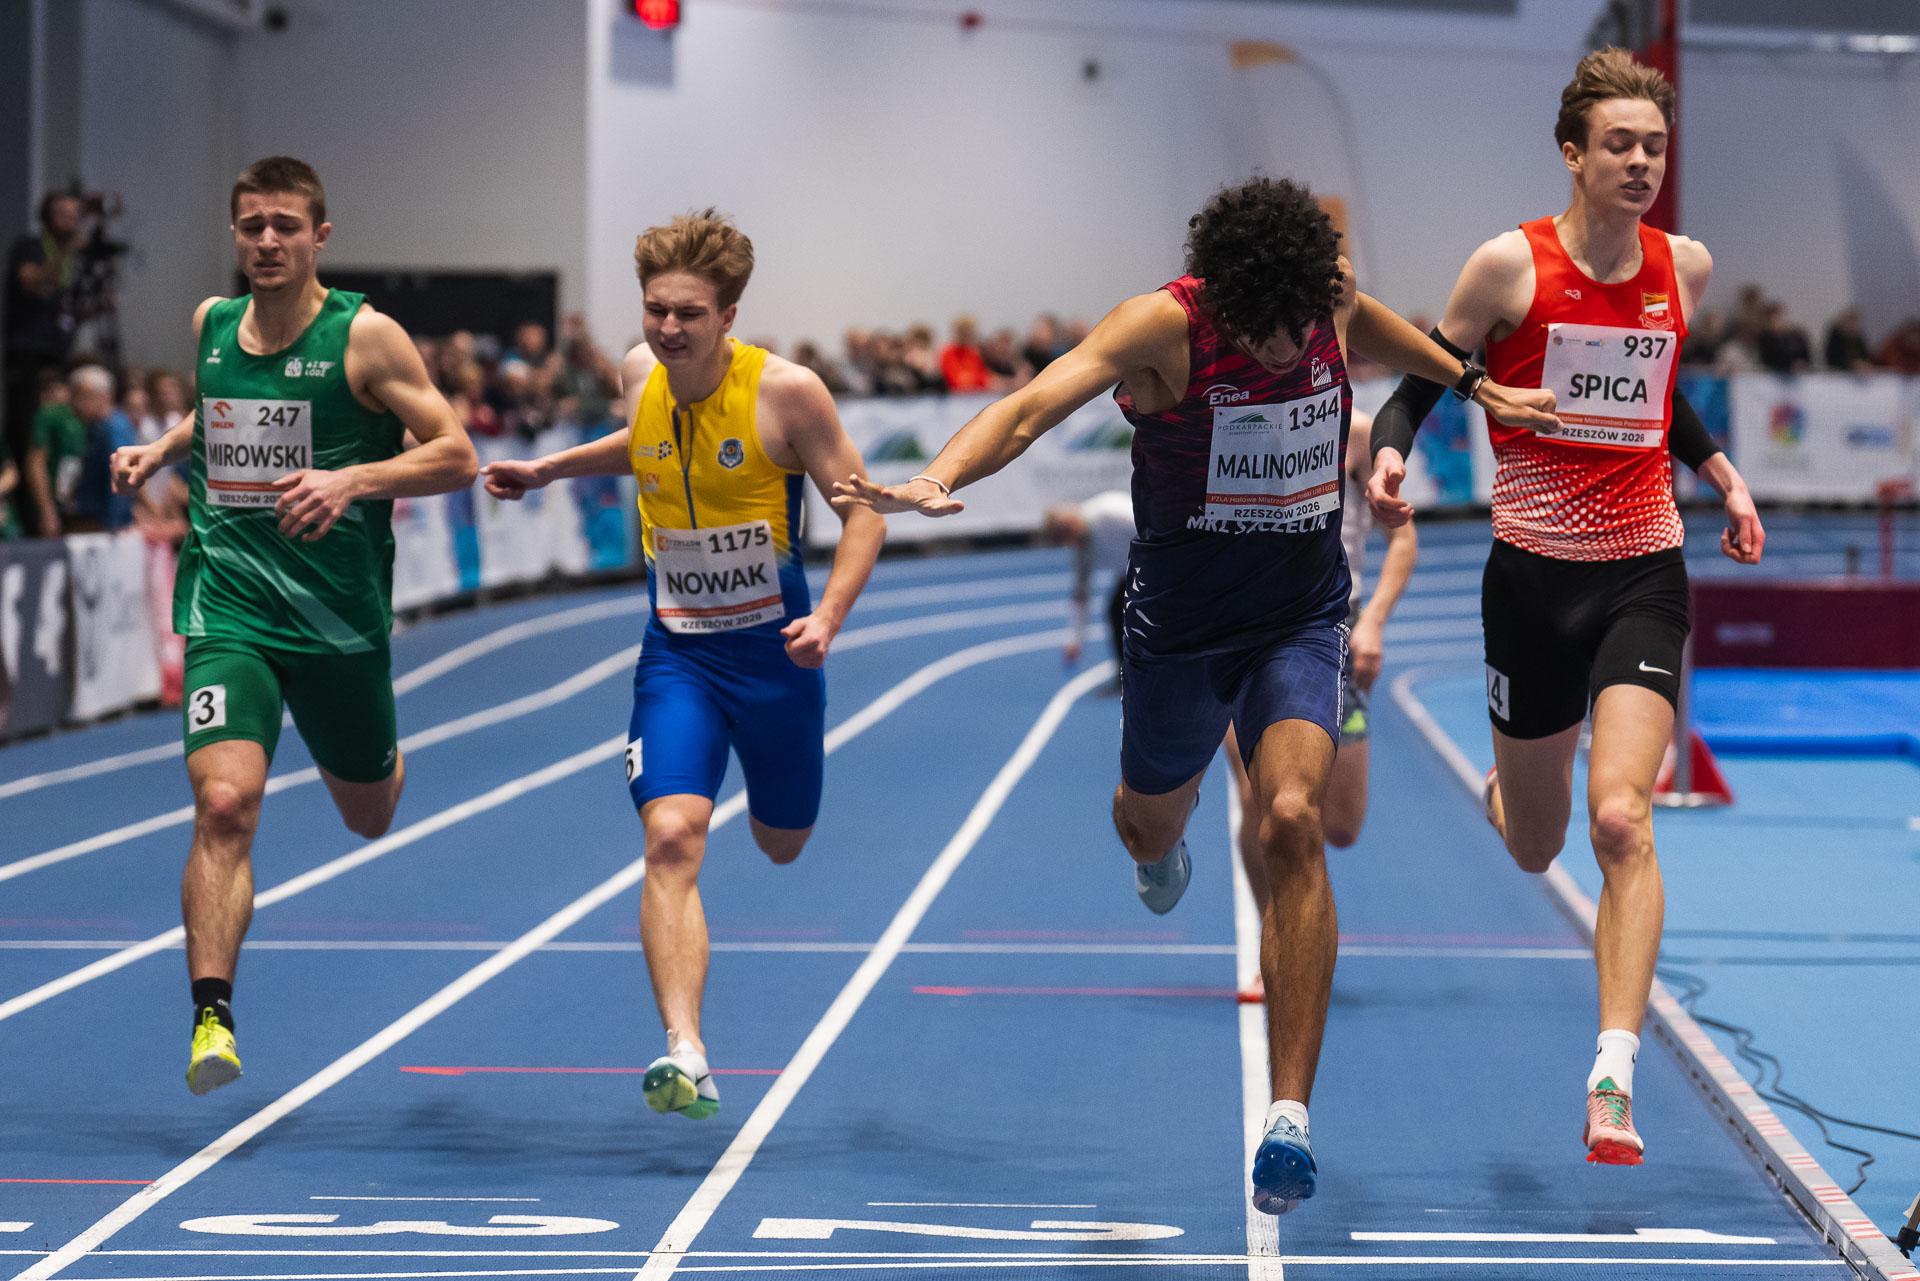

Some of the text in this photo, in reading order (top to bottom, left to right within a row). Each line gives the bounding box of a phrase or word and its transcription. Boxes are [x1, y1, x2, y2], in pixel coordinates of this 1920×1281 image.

[1623, 335, 1668, 359] 937
[1209, 390, 1250, 405] Enea
[1568, 373, 1648, 404] SPICA
[256, 406, 301, 428] 247
[1288, 393, 1340, 432] 1344
[1217, 423, 1283, 431] PODKARPACKIE
[1561, 427, 1645, 442] RZESZÓW 2026
[208, 443, 306, 468] MIROWSKI
[1216, 439, 1335, 480] MALINOWSKI
[1234, 501, 1321, 520] RZESZÓW 2026
[708, 525, 768, 554] 1175
[666, 562, 768, 595] NOWAK
[681, 619, 733, 630] RZESZÓW
[1491, 673, 1504, 713] 4
[195, 690, 215, 726] 3
[624, 747, 634, 782] 6
